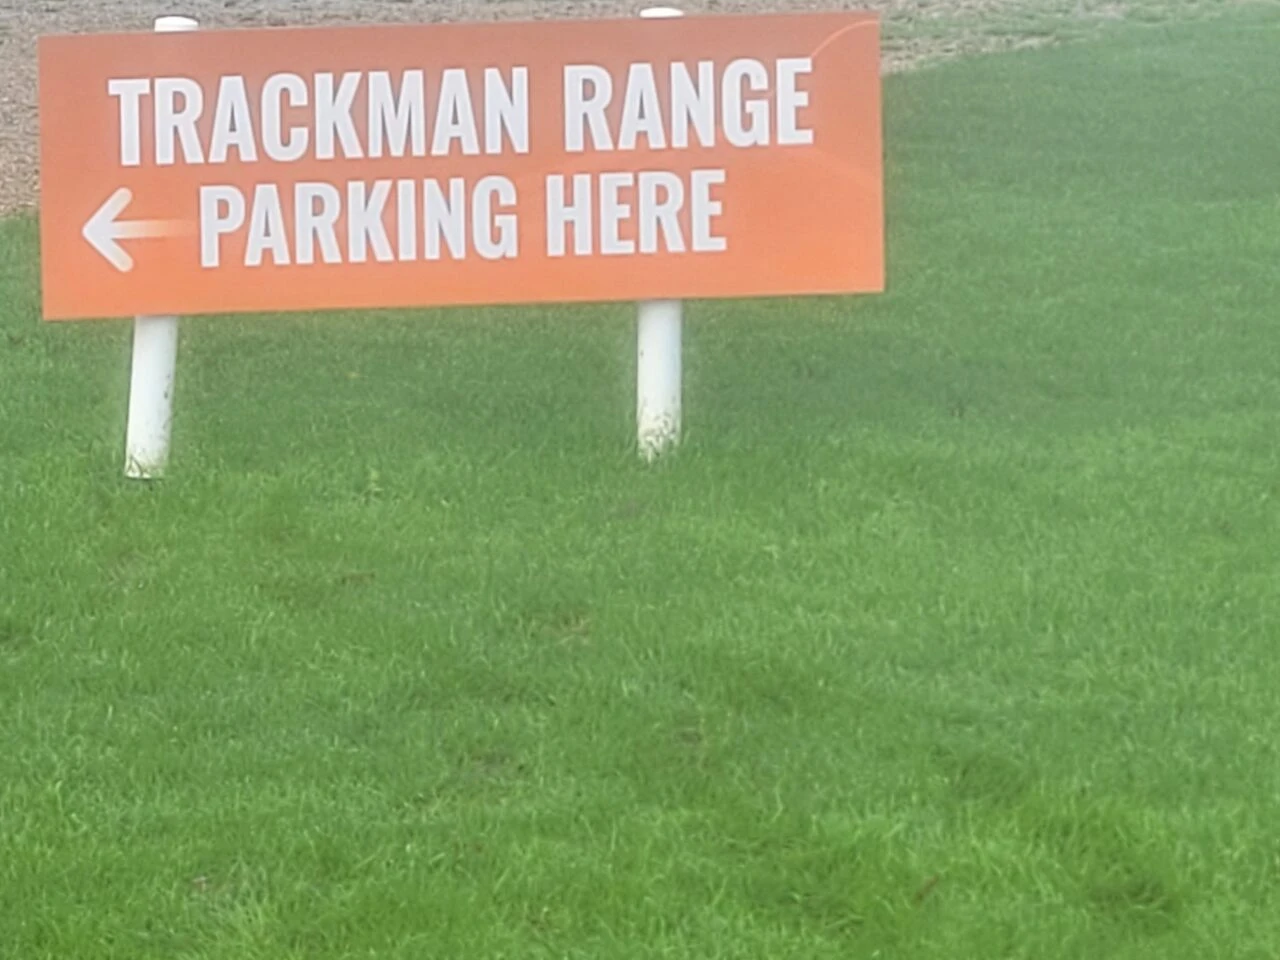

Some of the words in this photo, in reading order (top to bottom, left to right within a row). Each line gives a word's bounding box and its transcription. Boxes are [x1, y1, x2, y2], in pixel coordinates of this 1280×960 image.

[109, 67, 529, 166] TRACKMAN
[563, 57, 815, 152] RANGE
[200, 176, 519, 267] PARKING
[546, 169, 727, 257] HERE
